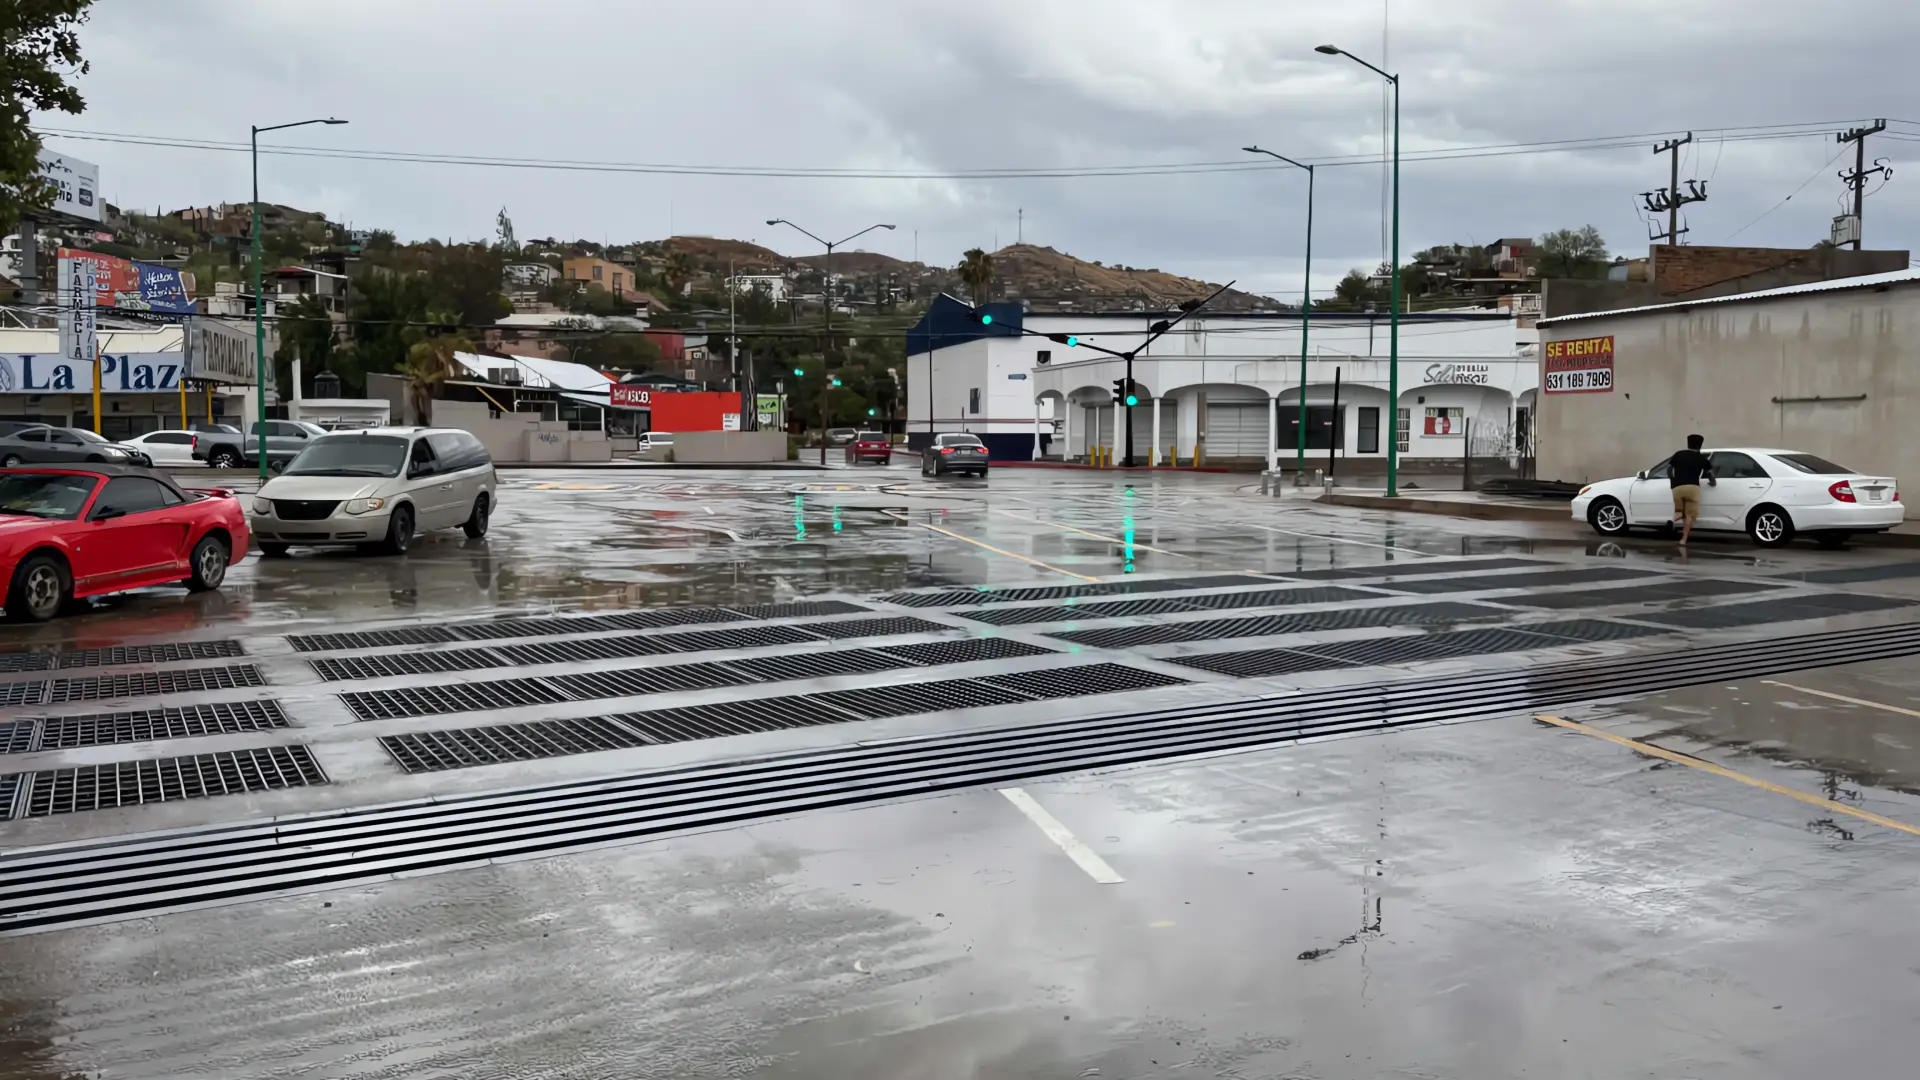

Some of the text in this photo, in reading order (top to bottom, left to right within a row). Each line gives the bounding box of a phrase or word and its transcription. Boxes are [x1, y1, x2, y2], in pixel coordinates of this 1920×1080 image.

[1547, 337, 1612, 357] SE RENTA
[18, 354, 75, 390] La
[1546, 373, 1563, 389] 631
[1567, 373, 1584, 388] 189
